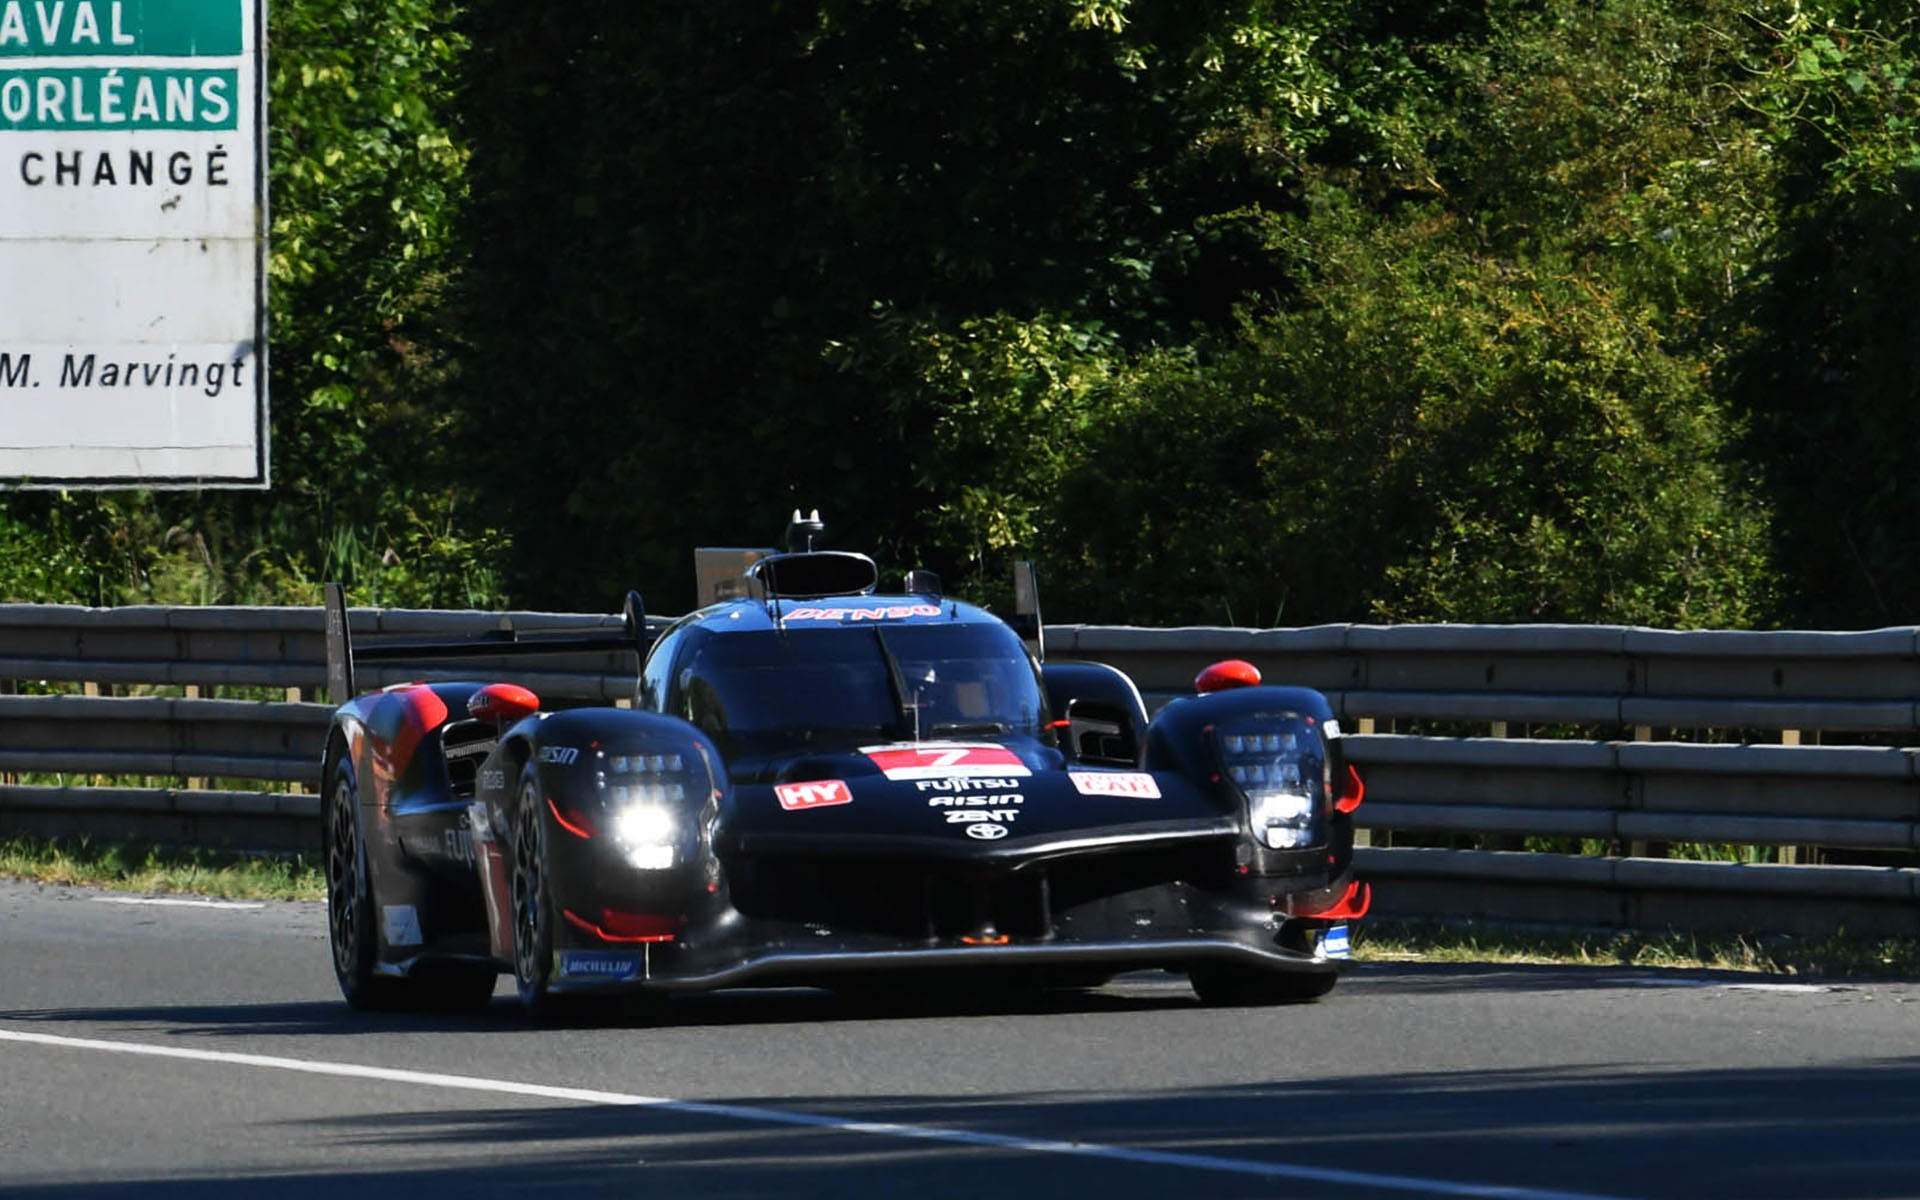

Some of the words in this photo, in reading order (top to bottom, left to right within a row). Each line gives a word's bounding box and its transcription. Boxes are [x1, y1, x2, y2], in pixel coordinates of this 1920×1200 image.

[0, 0, 135, 45] AVAL
[1, 68, 230, 123] ORLÉANS
[21, 144, 229, 186] CHANGÉ
[0, 352, 40, 388] M.
[59, 353, 244, 398] Marvingt
[781, 605, 942, 621] DENSO
[916, 749, 970, 766] 7
[782, 783, 840, 805] HY
[915, 777, 1019, 793] FUJITSU
[943, 809, 1020, 823] ZENT
